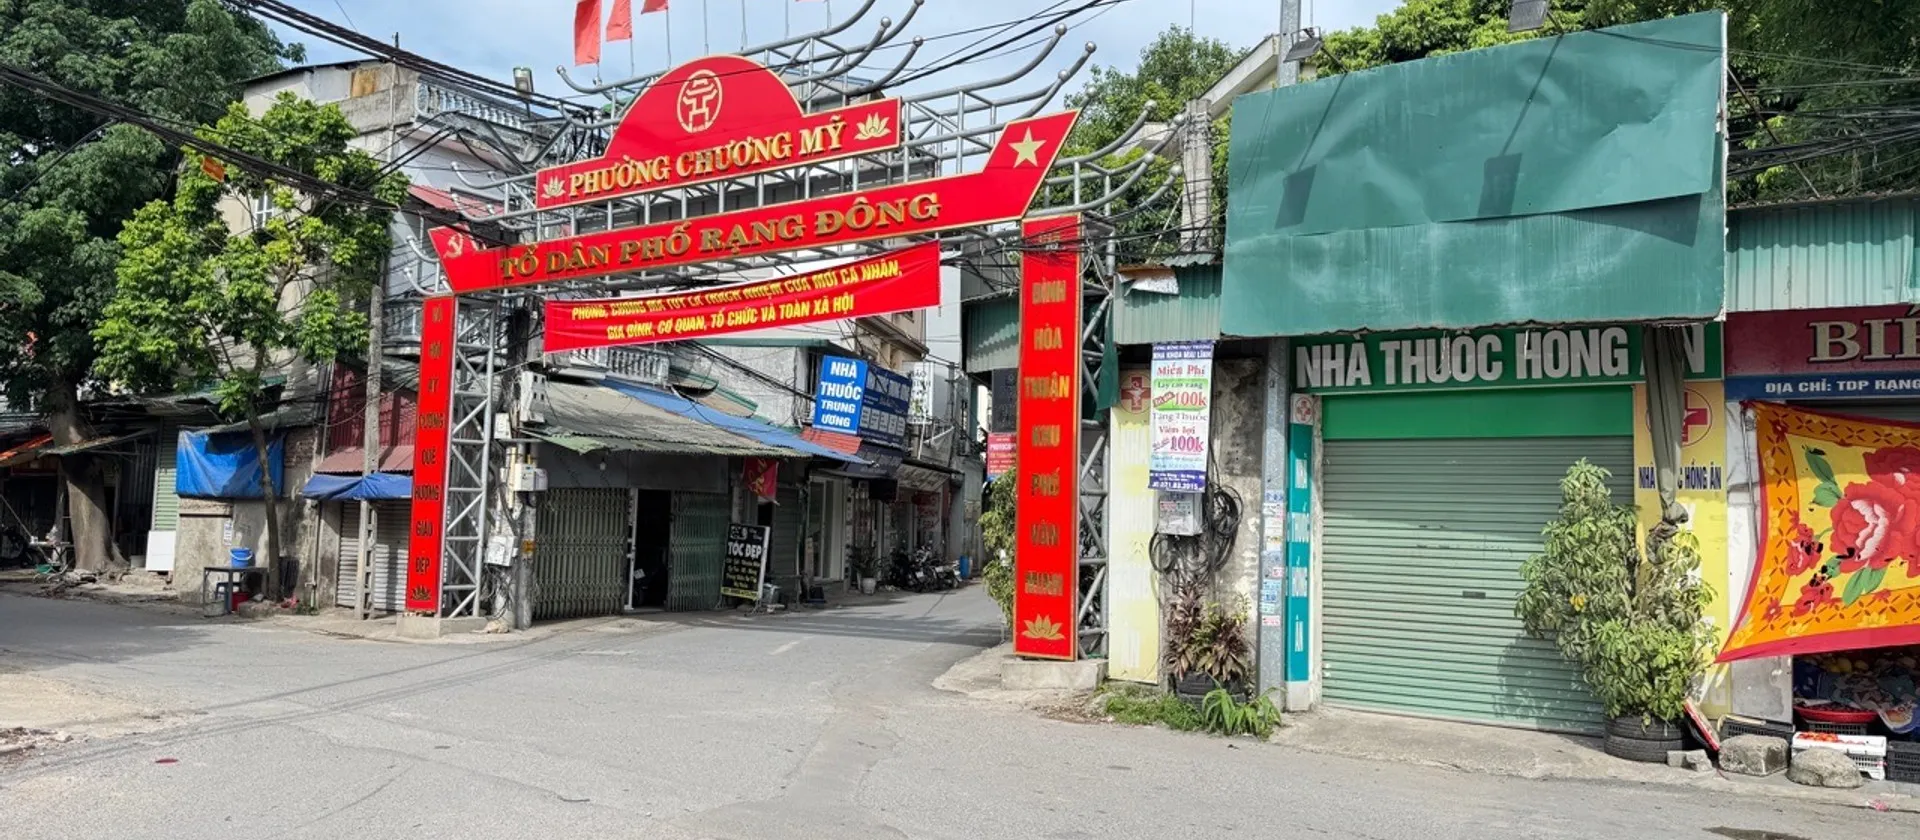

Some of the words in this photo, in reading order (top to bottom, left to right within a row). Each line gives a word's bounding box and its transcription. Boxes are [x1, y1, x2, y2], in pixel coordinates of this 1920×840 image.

[569, 154, 671, 197] PHƯỜNG
[676, 131, 793, 177] CHƯƠNG
[798, 115, 847, 155] MỸ
[500, 243, 540, 279] TỔ
[546, 241, 611, 274] DÂN
[620, 221, 692, 264] PHỐ
[699, 213, 807, 254] RẠNG
[814, 192, 942, 235] ĐÔNG
[657, 318, 673, 334] CƠ
[727, 306, 758, 326] CHỨC
[761, 302, 776, 322] VÀ
[779, 298, 810, 319] TOÀN
[813, 296, 830, 315] XÃ
[833, 291, 854, 314] HỘI
[1033, 322, 1063, 351] HÒA
[830, 361, 857, 378] NHÀ
[1297, 333, 1371, 388] NHÀ
[820, 381, 863, 400] THUỐC
[1024, 371, 1070, 402] THUẬN
[1765, 382, 1794, 394] ĐỊA
[1798, 378, 1832, 392] CHỈ:
[1836, 380, 1870, 391] TDP
[821, 399, 856, 414] TRUNG
[1176, 391, 1207, 406] 100k
[821, 413, 851, 427] ƯƠNG
[1170, 435, 1204, 452] 100k
[727, 541, 744, 556] TÓC
[745, 543, 762, 560] ĐẸP
